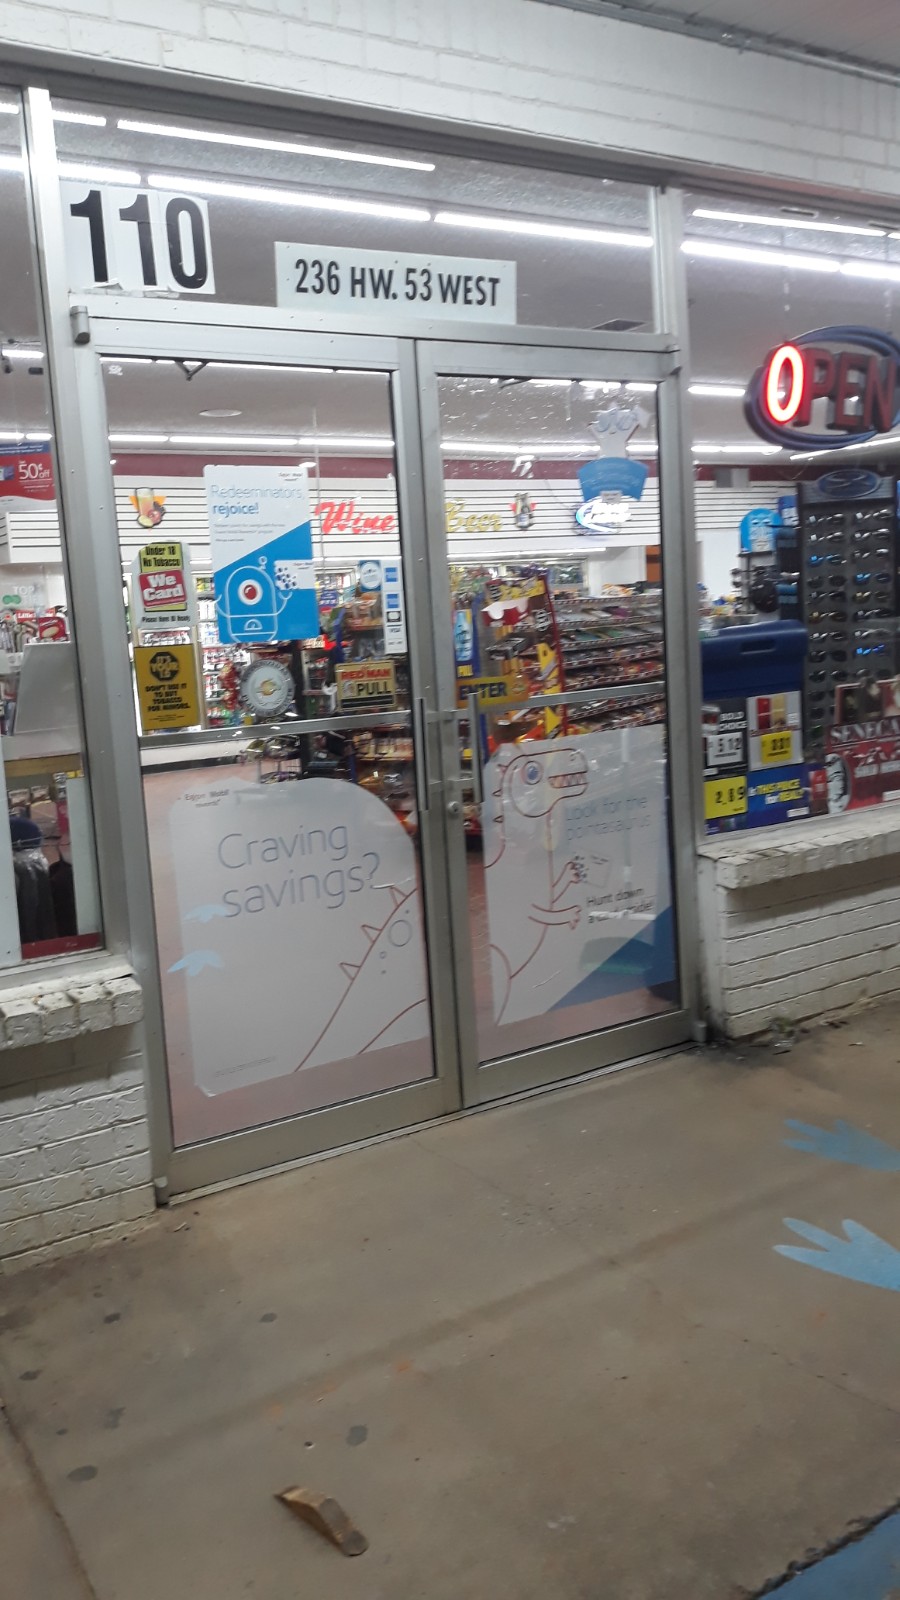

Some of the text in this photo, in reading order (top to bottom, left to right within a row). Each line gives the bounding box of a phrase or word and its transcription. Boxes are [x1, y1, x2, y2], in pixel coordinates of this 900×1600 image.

[70, 189, 208, 289] 110
[294, 258, 501, 306] 236 HW. 53 WEST
[760, 343, 897, 433] OPEN
[212, 502, 260, 518] rejoice!
[314, 500, 396, 535] Wine
[145, 546, 166, 556] Under
[152, 557, 181, 568] Tobacco
[147, 573, 177, 588] We
[143, 584, 185, 600] Card
[341, 670, 365, 680] RED
[356, 681, 392, 696] PULL
[458, 681, 508, 700] ENTER
[217, 825, 349, 869] Craving
[222, 852, 381, 918] savings?
